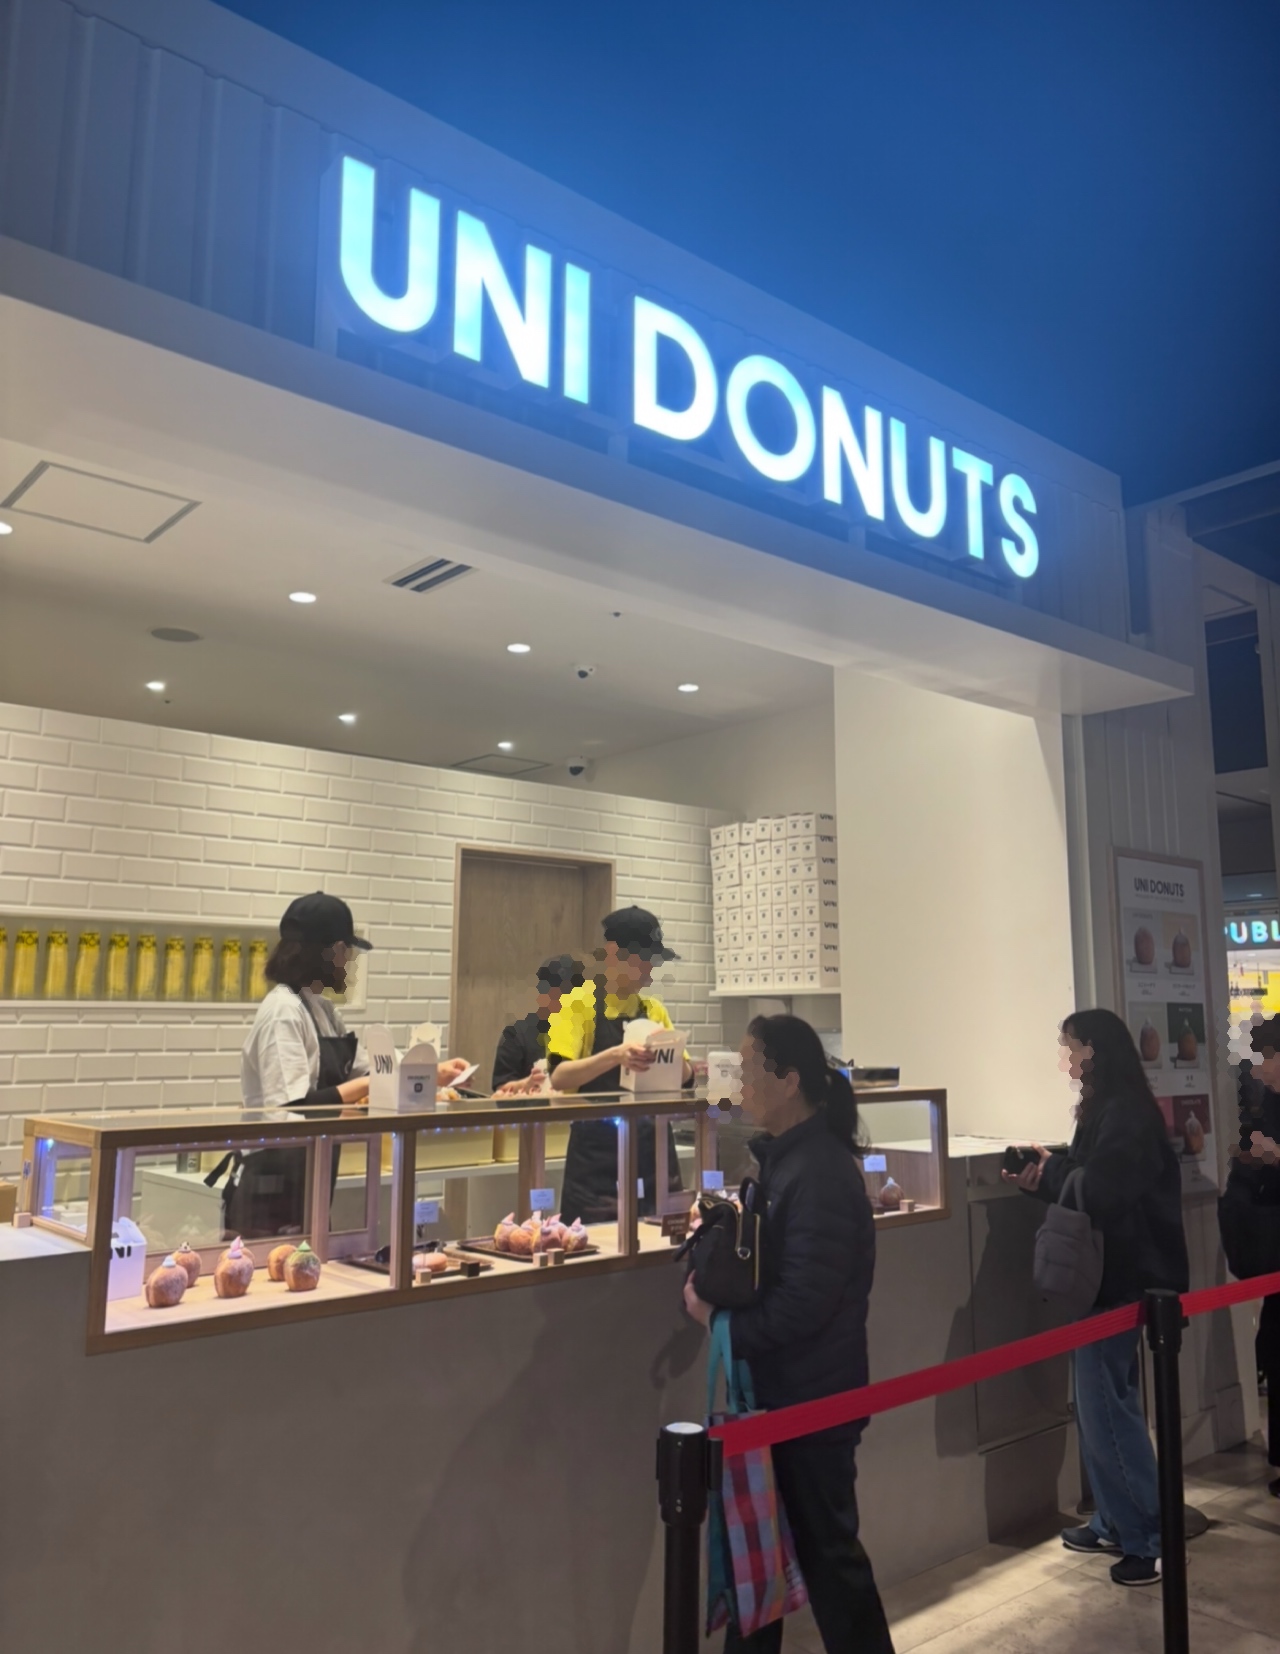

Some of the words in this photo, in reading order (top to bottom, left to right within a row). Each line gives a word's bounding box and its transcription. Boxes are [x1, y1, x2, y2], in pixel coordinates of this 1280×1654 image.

[340, 155, 590, 404] UNI
[634, 295, 1039, 578] DONUTS
[1134, 877, 1148, 892] UNI
[1150, 879, 1184, 897] DONUTS
[1225, 919, 1280, 944] UBL
[374, 1054, 393, 1075] UNI
